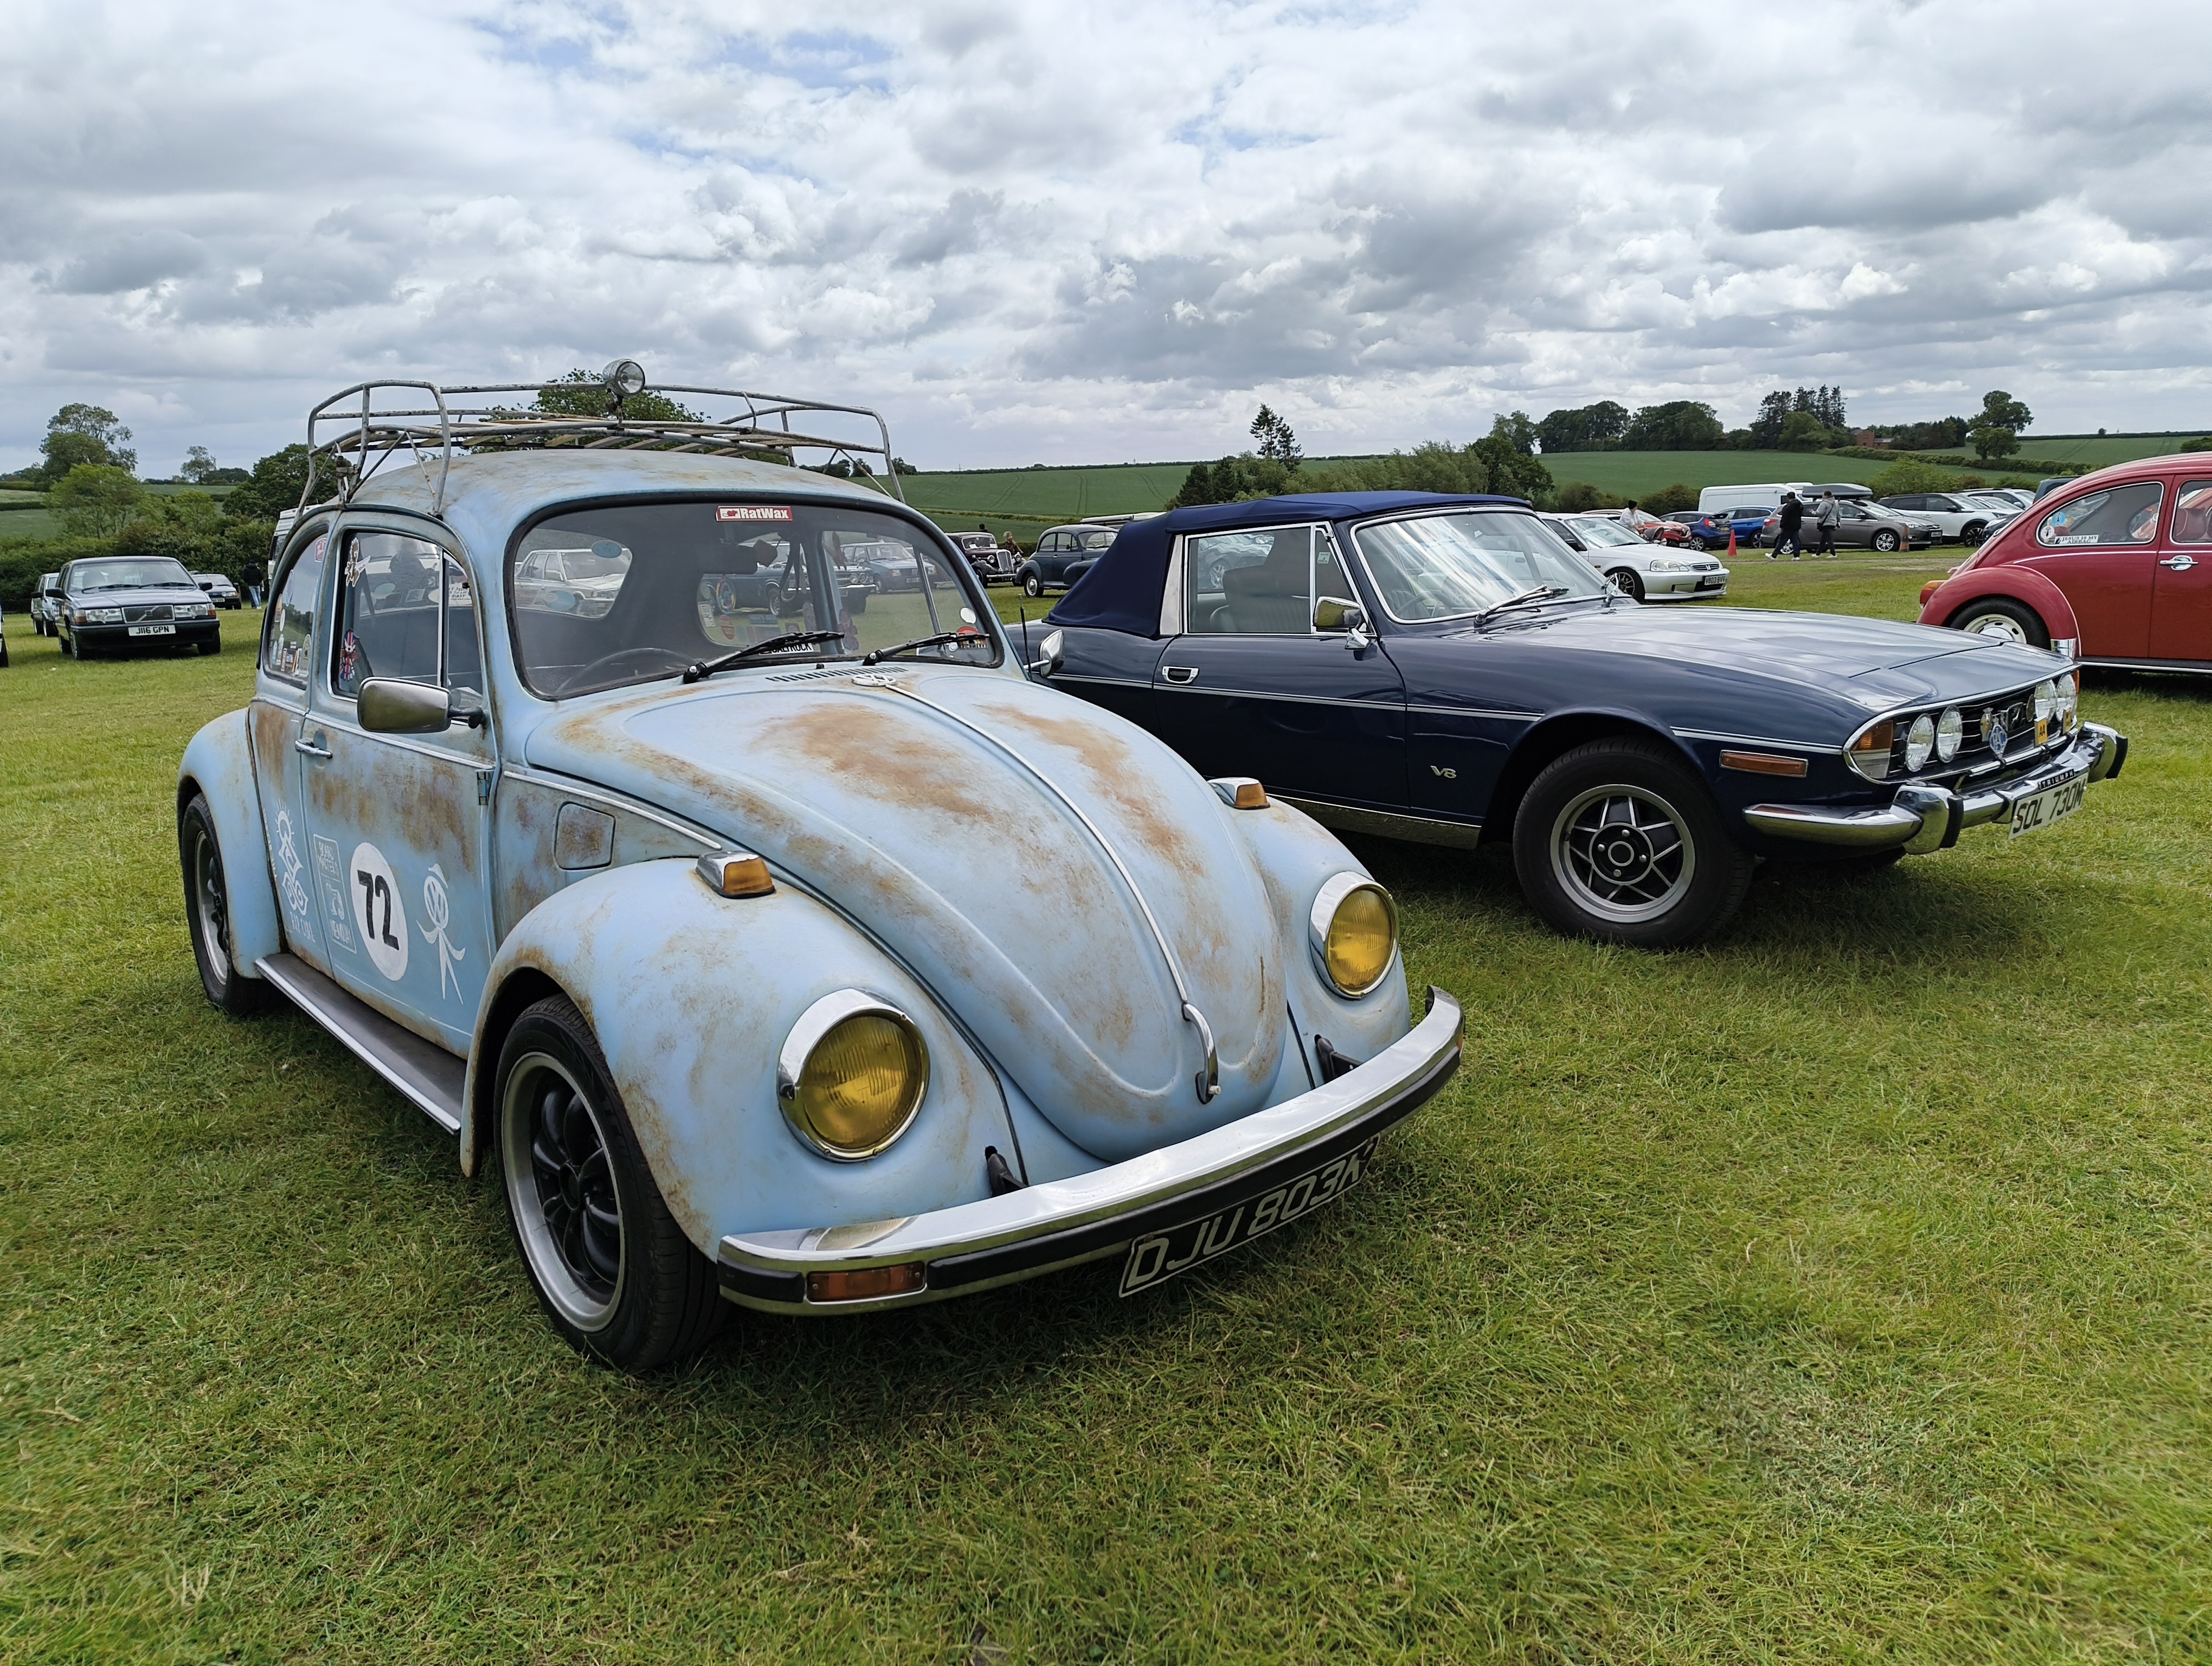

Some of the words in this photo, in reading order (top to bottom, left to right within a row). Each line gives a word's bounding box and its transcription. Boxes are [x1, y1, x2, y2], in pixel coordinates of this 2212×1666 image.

[740, 508, 789, 519] RatWax
[2039, 724, 2046, 737] AA
[2041, 770, 2074, 787] TRIUMPH
[2012, 797, 2043, 834] SOL
[2048, 777, 2086, 820] 730M
[357, 869, 400, 951] 72
[1126, 1207, 1245, 1289] DJU
[1248, 1142, 1374, 1236] 803K
